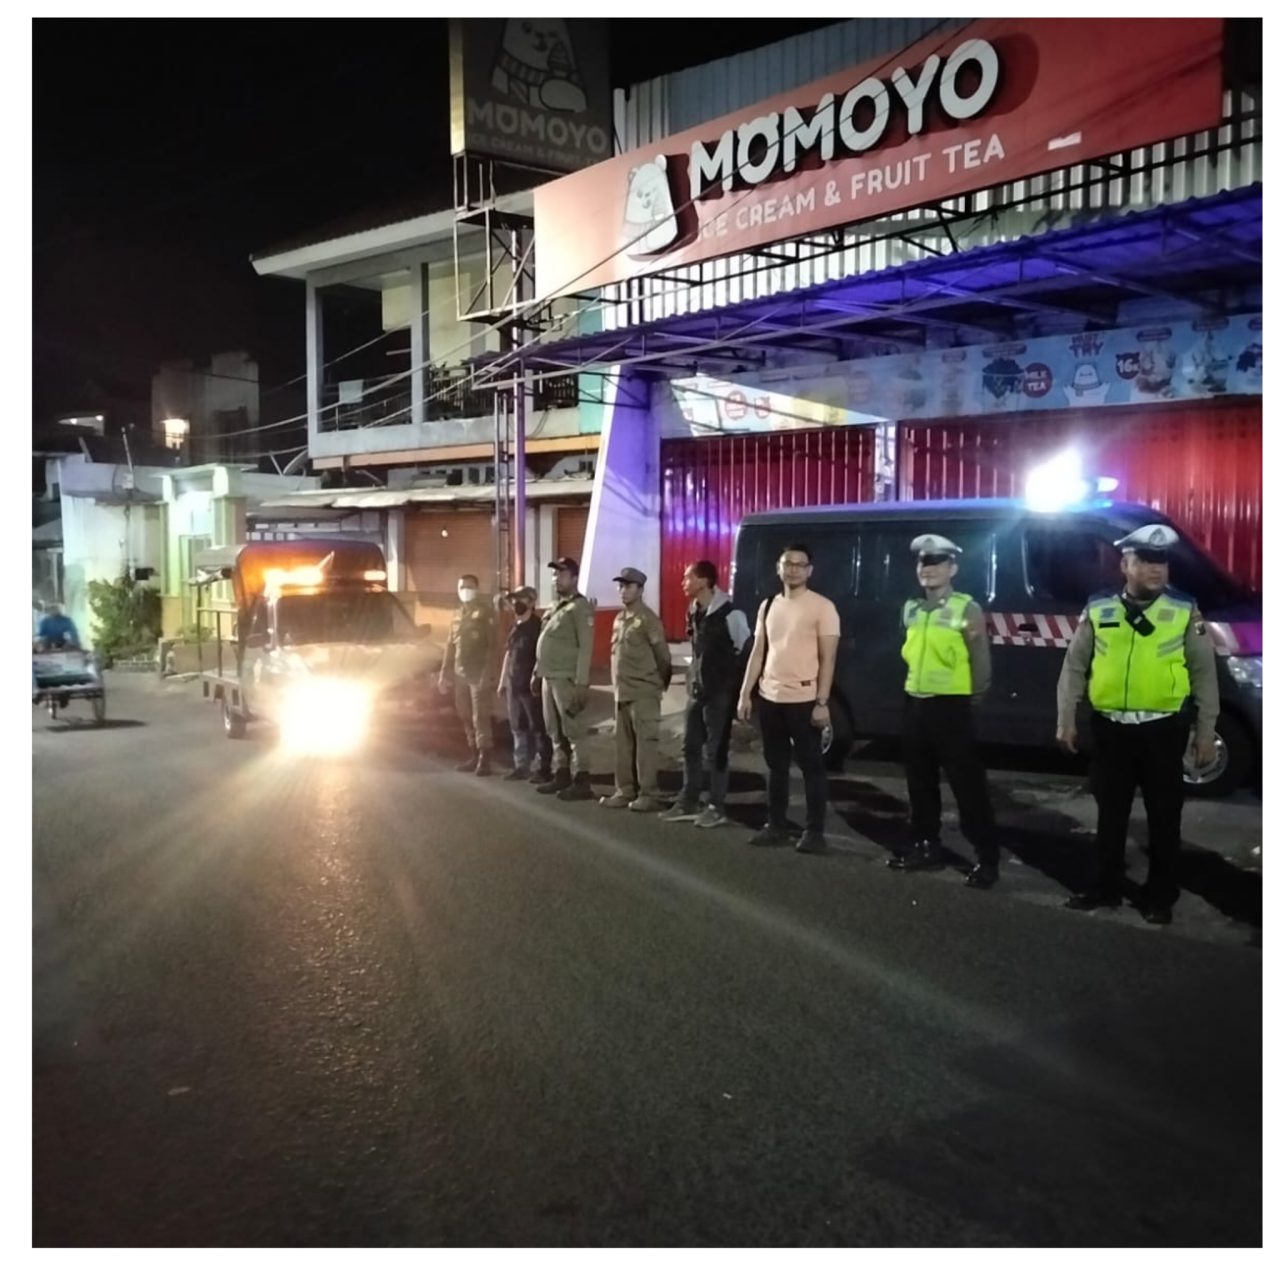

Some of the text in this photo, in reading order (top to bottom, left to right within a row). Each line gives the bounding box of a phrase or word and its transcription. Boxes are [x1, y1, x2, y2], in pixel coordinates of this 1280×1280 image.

[469, 97, 608, 154] MOMOYO
[690, 38, 999, 200] MOMOYO
[735, 186, 816, 229] CREAM
[824, 179, 841, 207] &
[850, 152, 932, 200] FRUIT
[942, 132, 1006, 174] TEA
[1068, 343, 1104, 358] TRY
[1024, 369, 1047, 379] MILK
[1027, 382, 1047, 392] TEA
